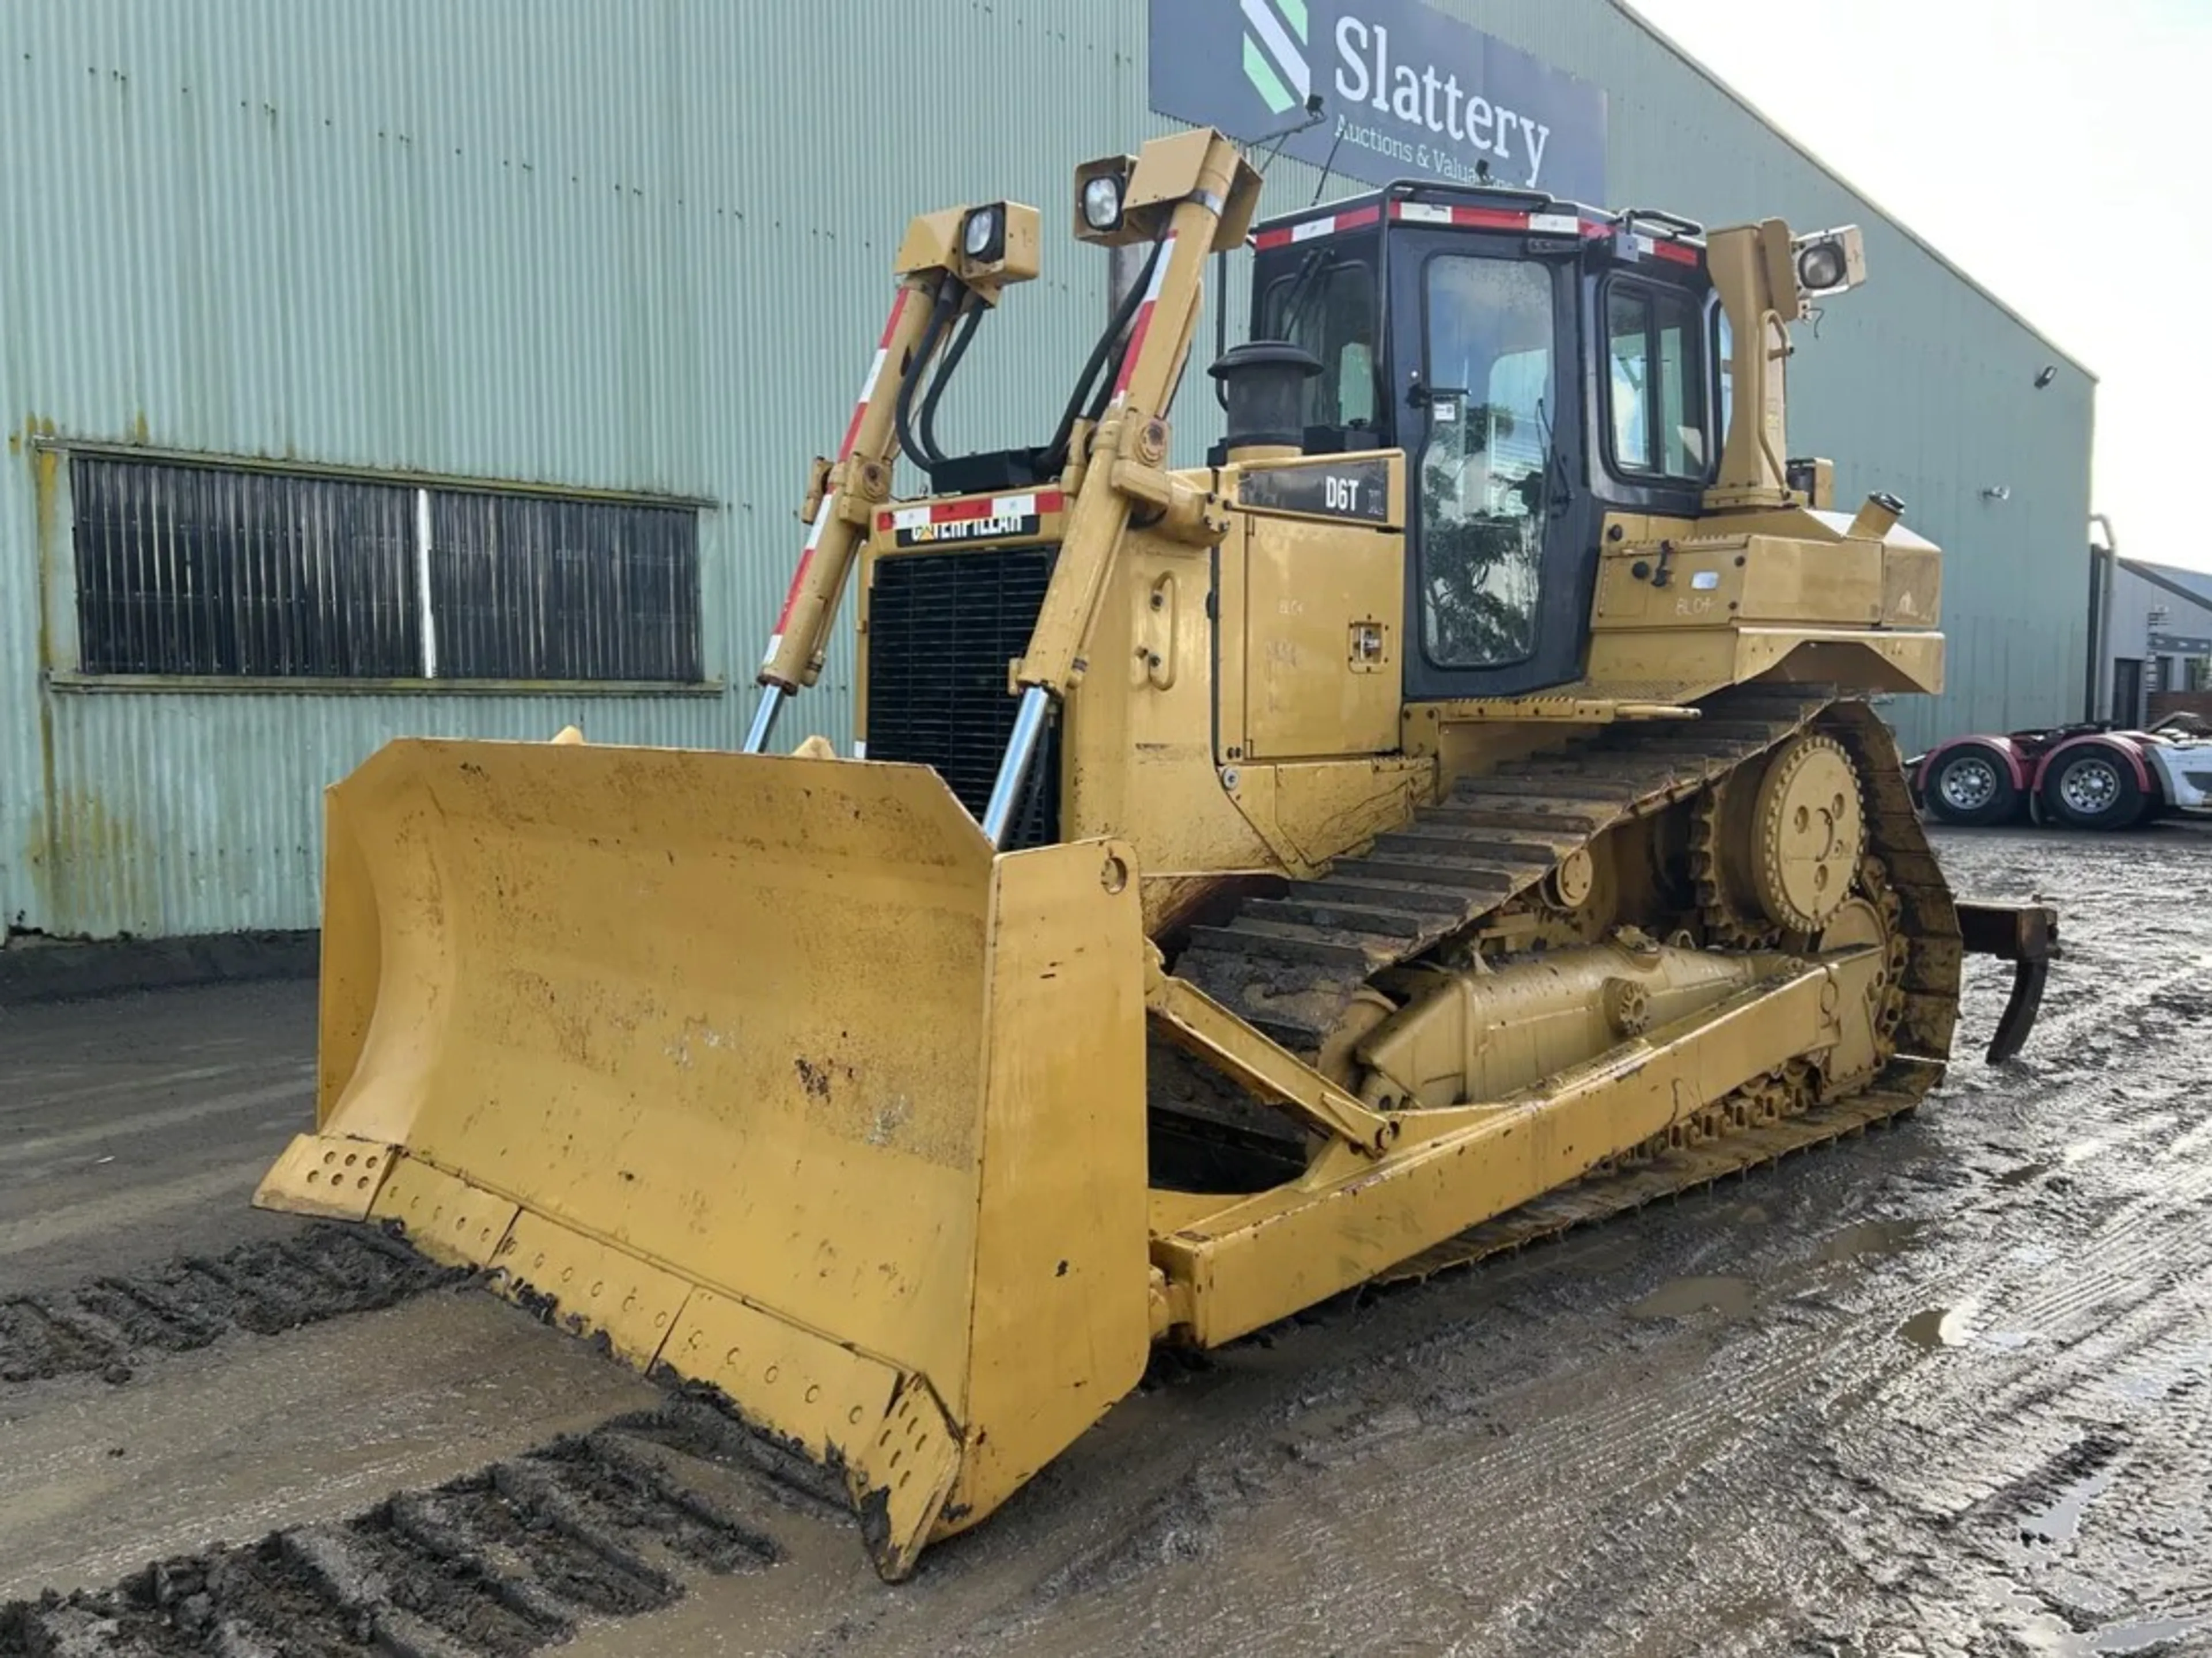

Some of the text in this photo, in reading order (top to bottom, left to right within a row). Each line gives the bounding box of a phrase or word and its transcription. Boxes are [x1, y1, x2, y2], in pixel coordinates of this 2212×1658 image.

[1334, 15, 1550, 189] Slattery
[1334, 114, 1515, 189] Auctions & Valua
[1325, 475, 1359, 511] D6T
